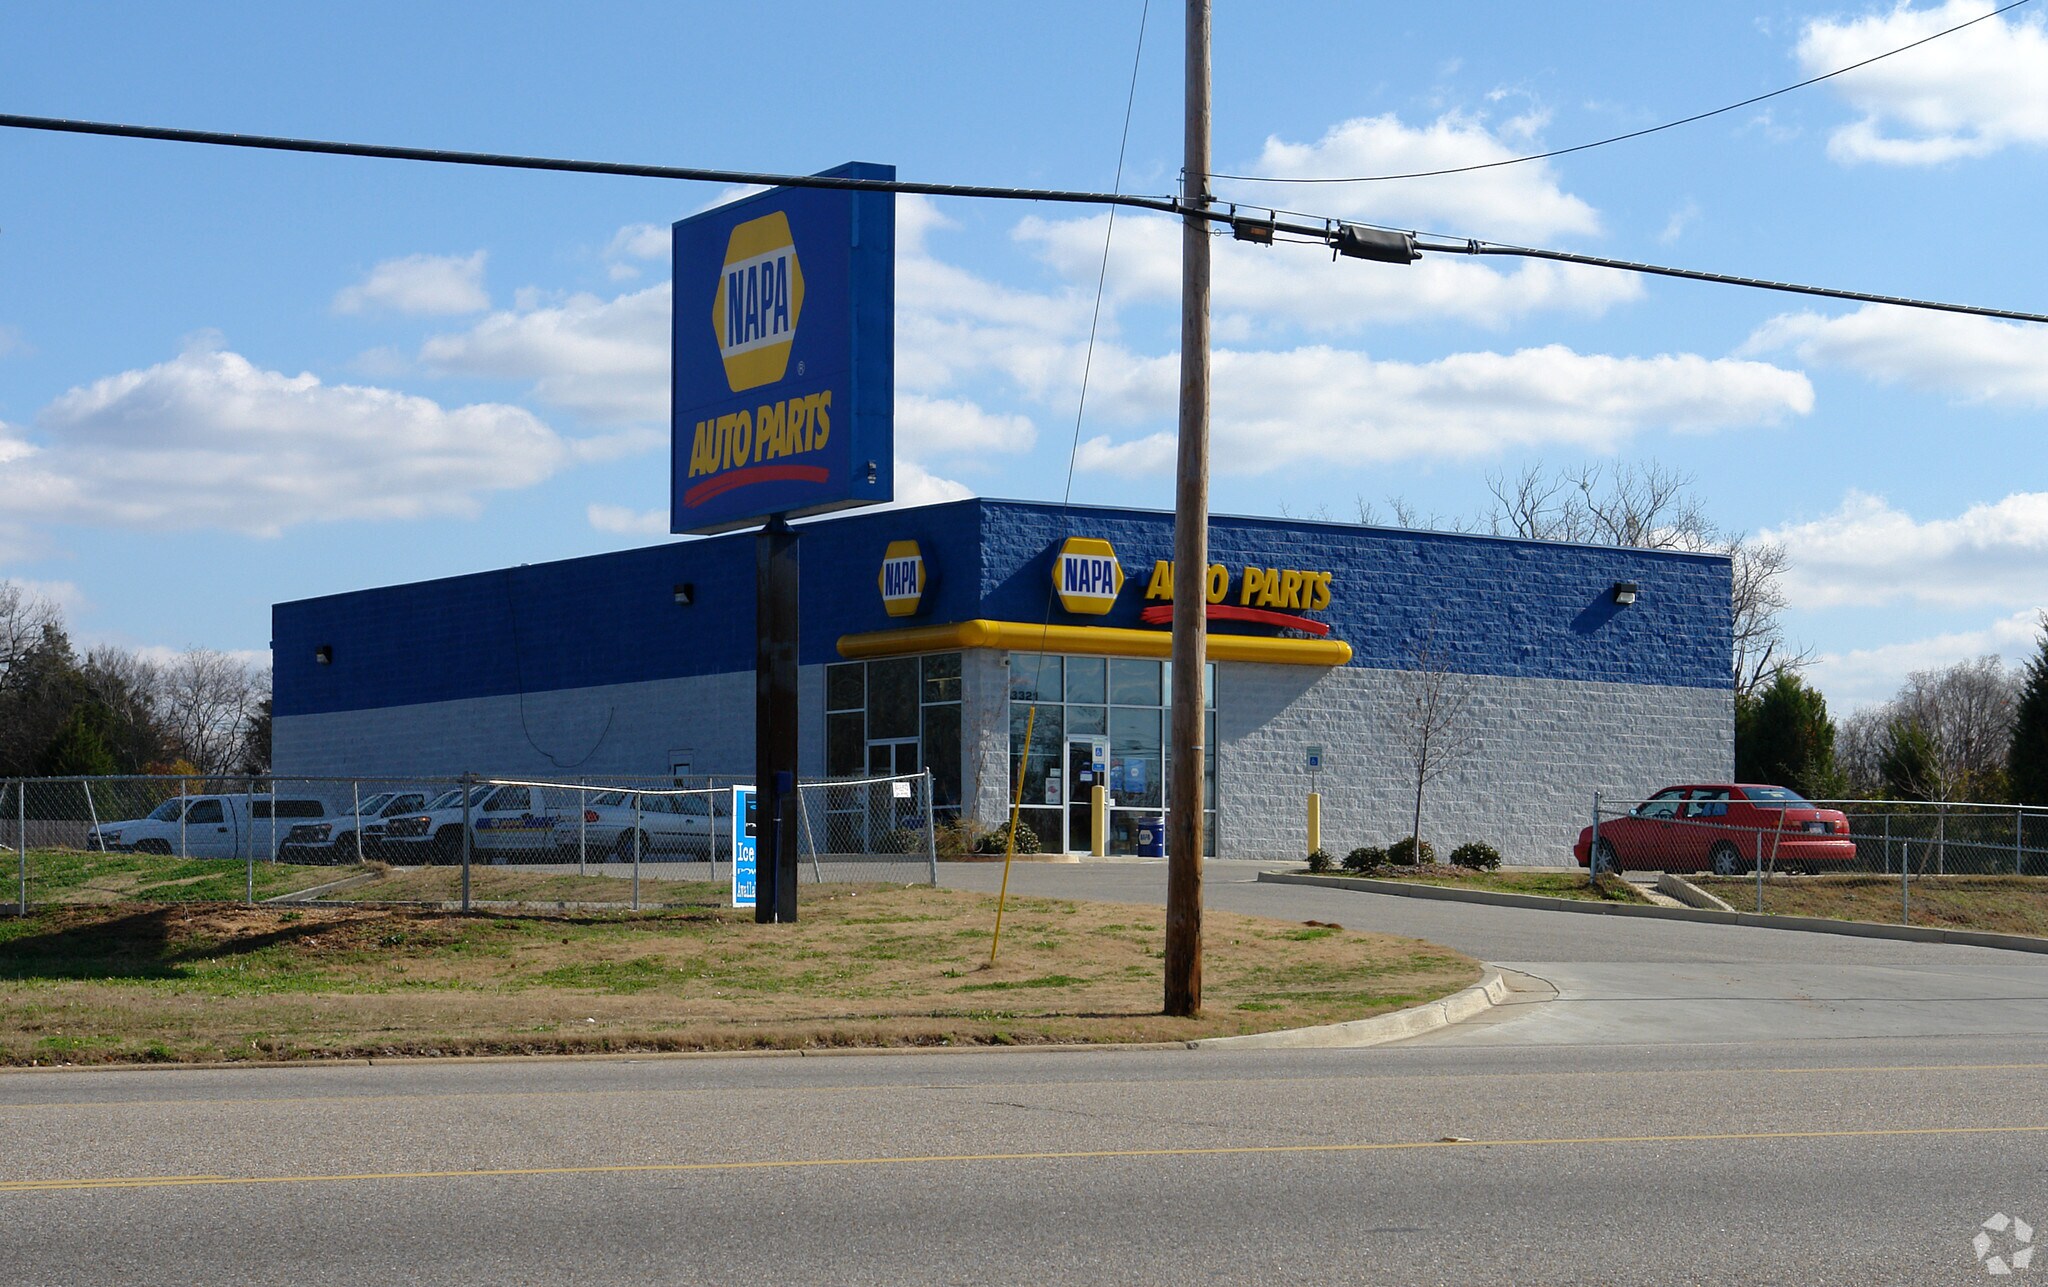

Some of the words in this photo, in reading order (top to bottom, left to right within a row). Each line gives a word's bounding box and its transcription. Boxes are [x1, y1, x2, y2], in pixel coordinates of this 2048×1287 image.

[729, 256, 788, 347] NAPA
[688, 410, 752, 478] AUTO
[754, 390, 832, 462] PARTS
[885, 559, 918, 597] NAPA
[1064, 557, 1114, 595] NAPA
[1144, 559, 1229, 604] AO
[1239, 566, 1332, 611] PARTS
[1009, 690, 1039, 701] 3321
[737, 842, 755, 862] Ice
